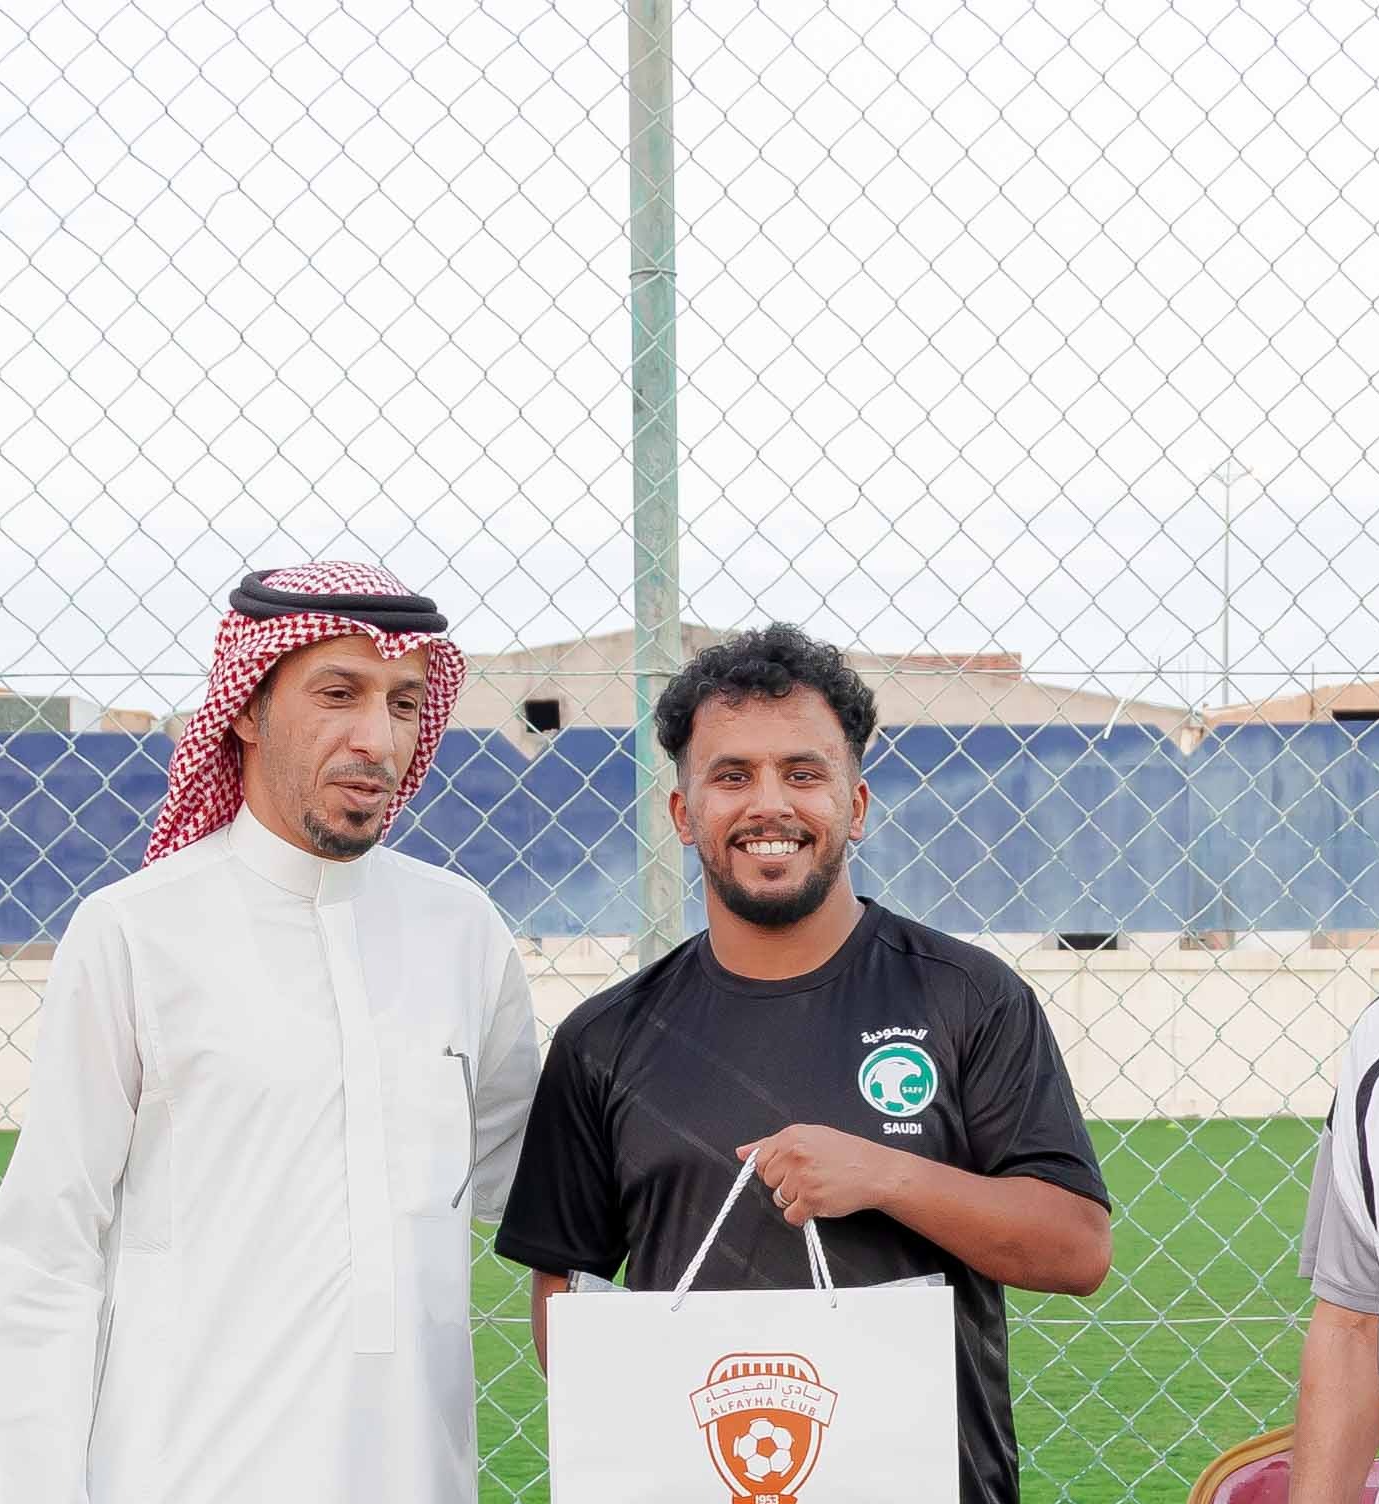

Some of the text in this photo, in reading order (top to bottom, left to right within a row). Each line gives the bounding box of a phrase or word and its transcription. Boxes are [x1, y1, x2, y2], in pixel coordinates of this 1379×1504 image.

[882, 1122, 922, 1134] SAUDI
[709, 1396, 817, 1418] ALFAYHA CLUB
